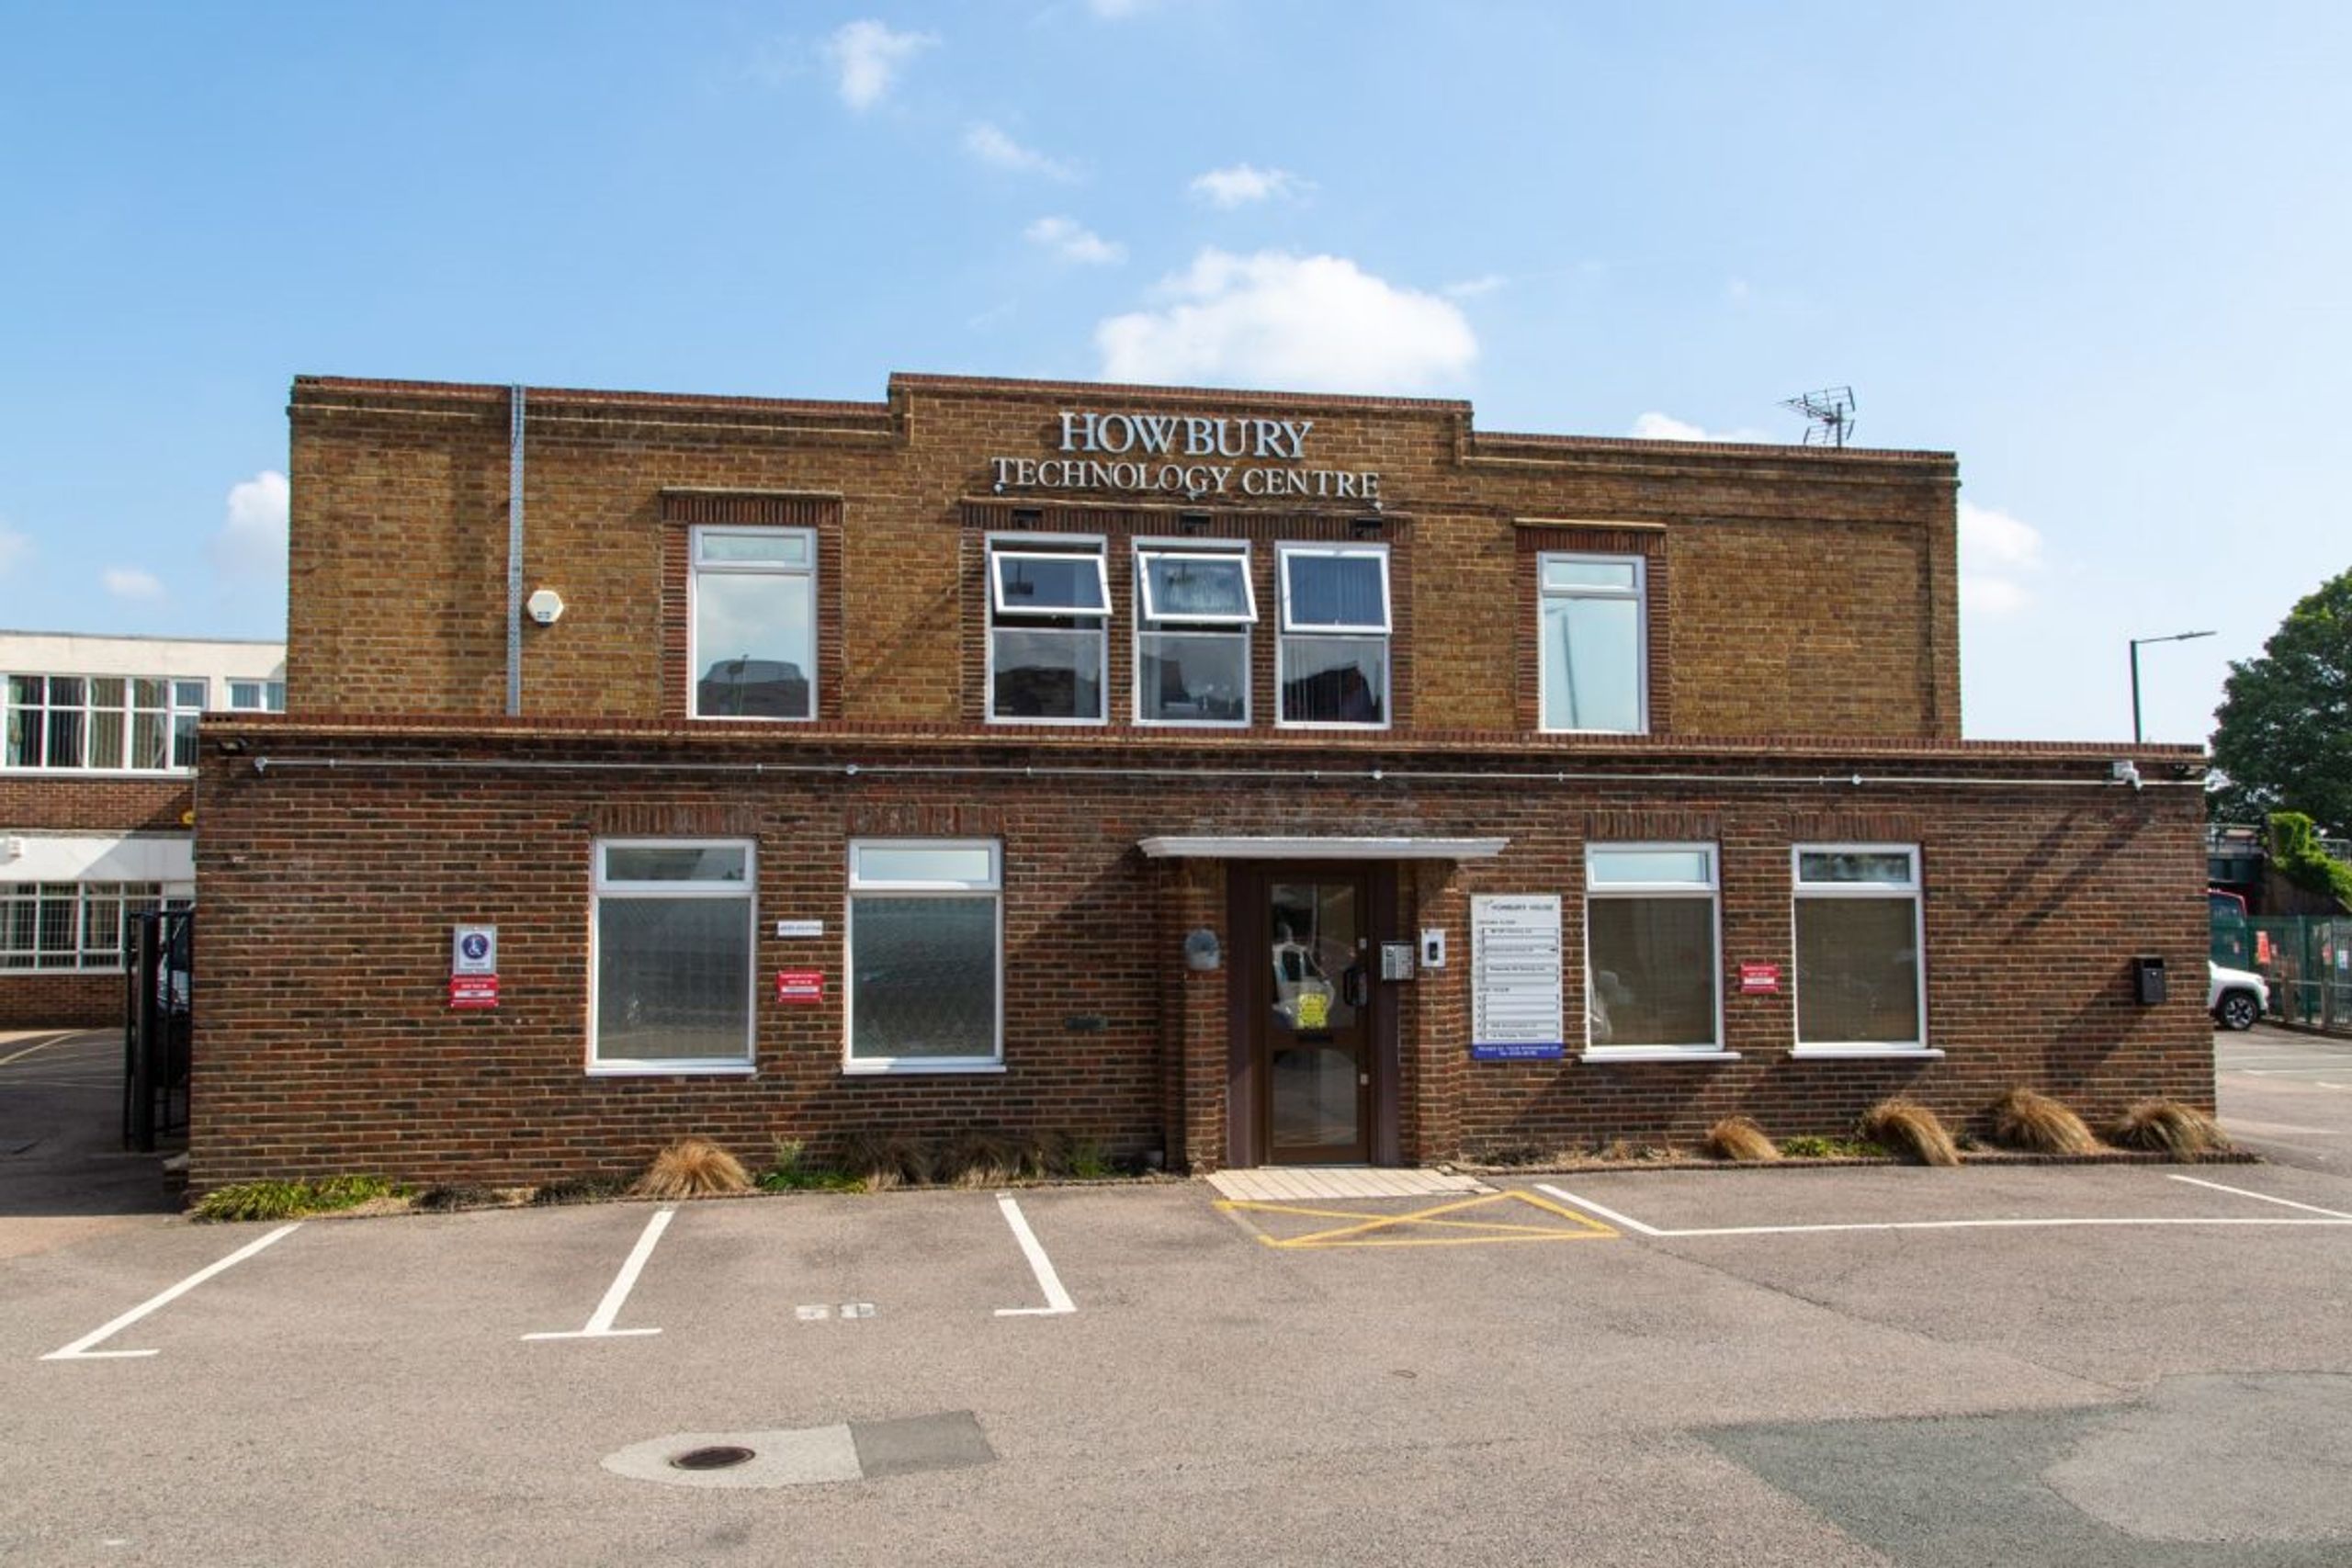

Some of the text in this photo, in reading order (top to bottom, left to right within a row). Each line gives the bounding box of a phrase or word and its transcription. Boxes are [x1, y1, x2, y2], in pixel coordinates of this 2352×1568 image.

[1058, 411, 1313, 458] HOWBURY
[991, 457, 1379, 499] TECHNOLOGY CENTRE
